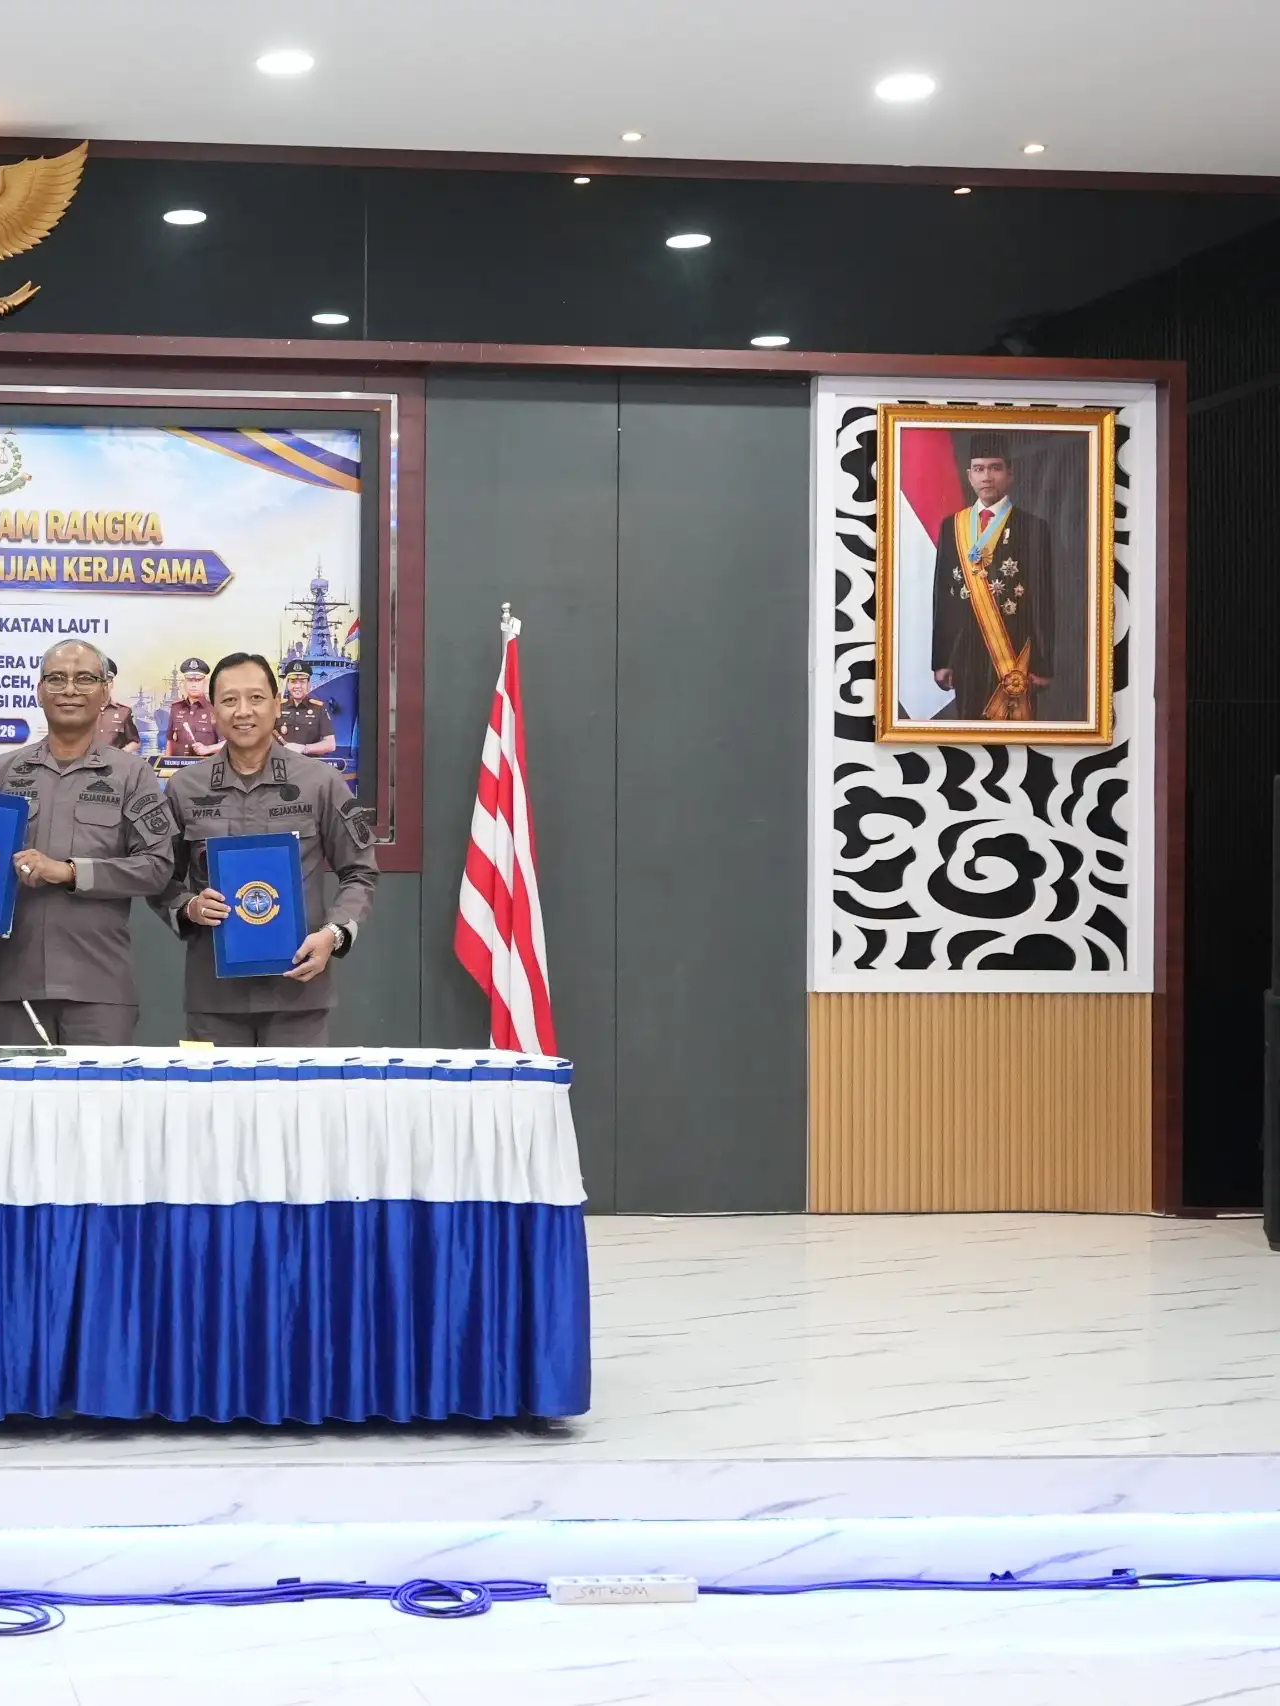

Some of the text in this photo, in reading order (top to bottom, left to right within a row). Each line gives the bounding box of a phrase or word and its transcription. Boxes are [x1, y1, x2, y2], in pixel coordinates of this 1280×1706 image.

[46, 510, 163, 544] RANGKA
[63, 556, 136, 584] KERJA
[141, 558, 208, 585] SAMA
[58, 618, 101, 634] LAUT
[104, 619, 109, 634] I
[12, 695, 38, 708] RIA
[192, 808, 221, 818] WIRA
[269, 804, 313, 817] KEJAKSAAN
